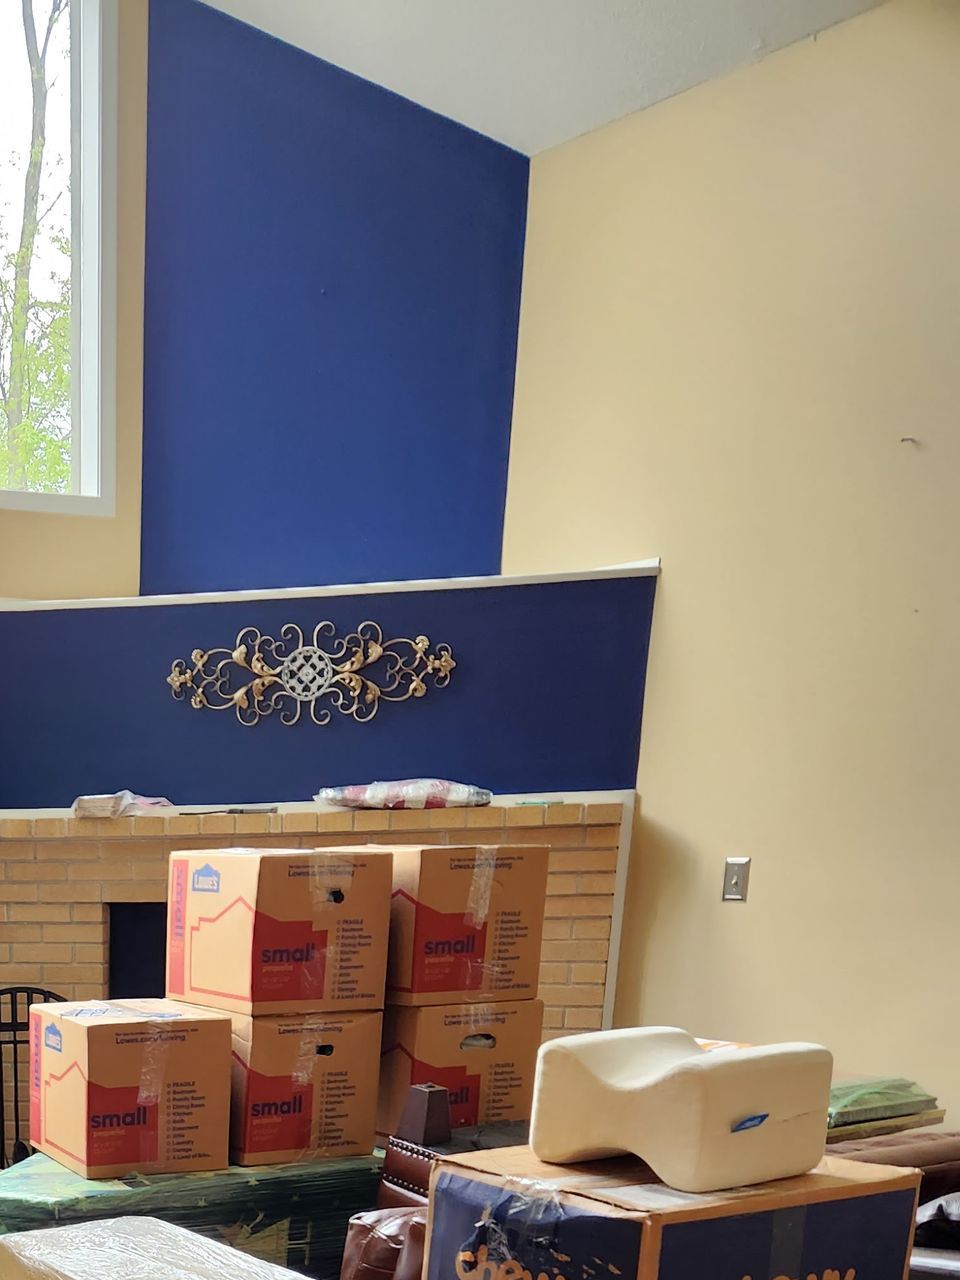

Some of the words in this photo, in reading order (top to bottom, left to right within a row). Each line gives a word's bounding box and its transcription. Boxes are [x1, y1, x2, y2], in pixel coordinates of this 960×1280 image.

[262, 943, 315, 963] small
[424, 935, 476, 955] small
[448, 1085, 470, 1105] all
[251, 1095, 303, 1117] small
[91, 1106, 147, 1129] small
